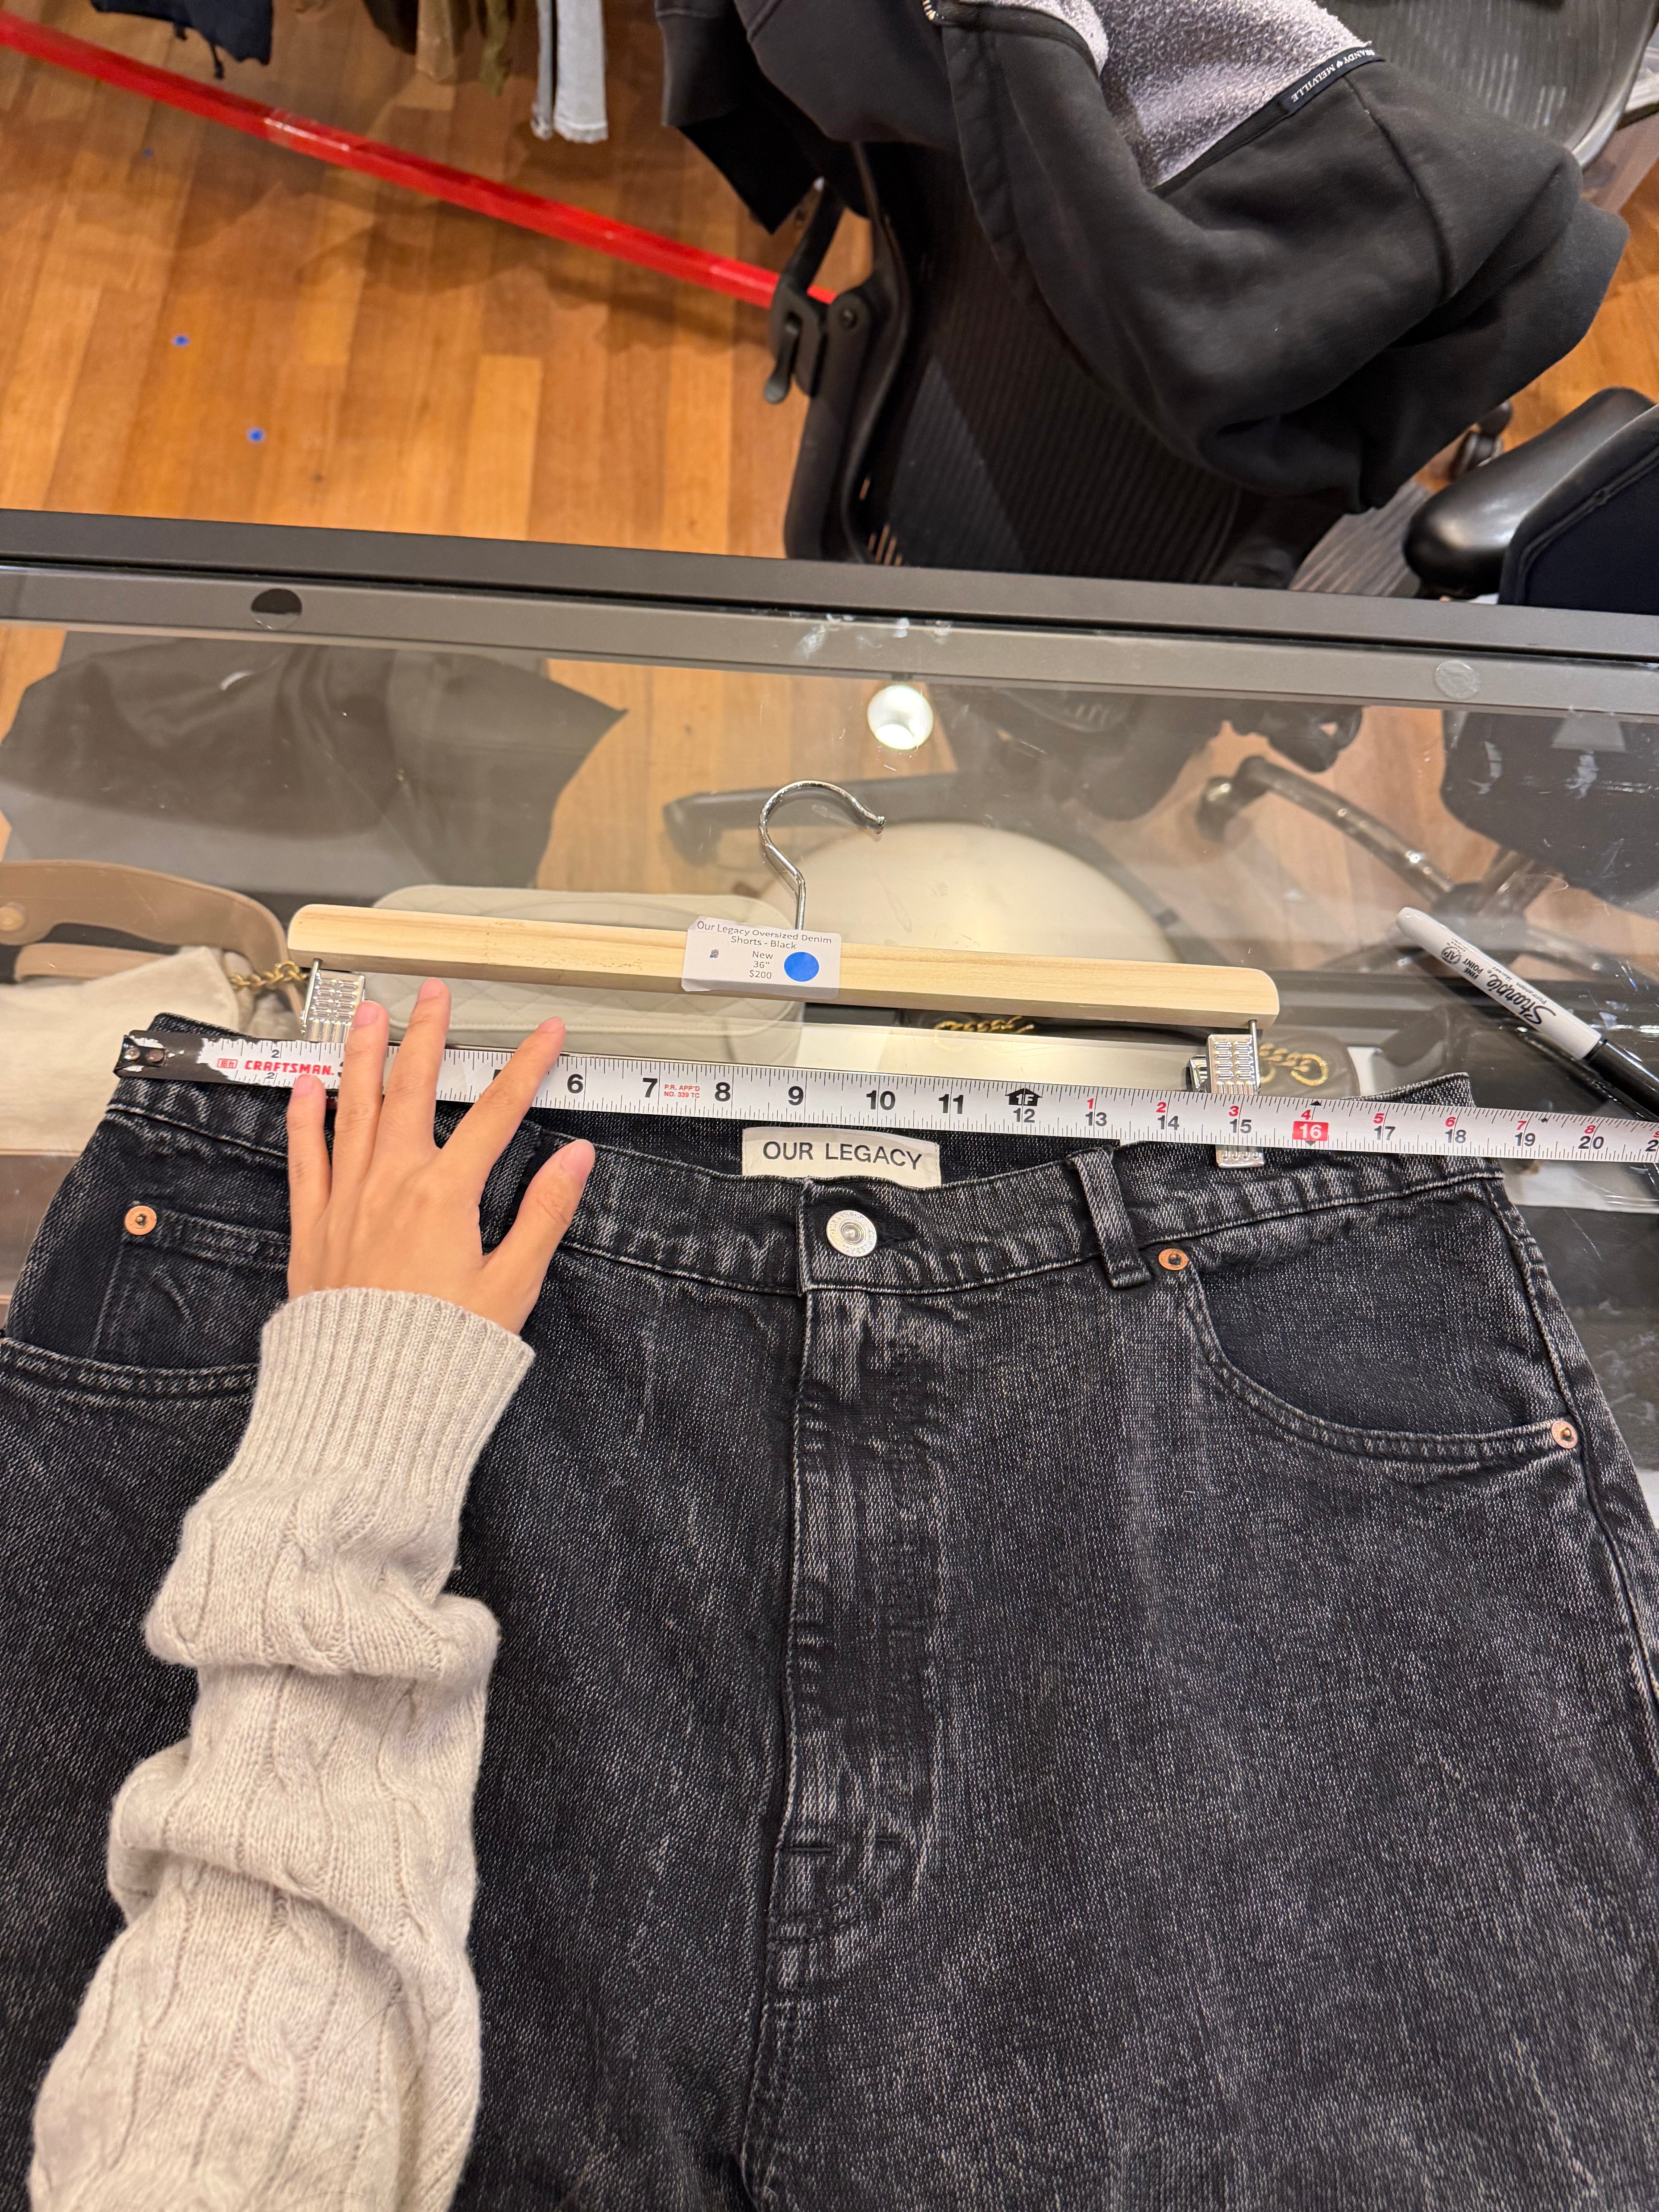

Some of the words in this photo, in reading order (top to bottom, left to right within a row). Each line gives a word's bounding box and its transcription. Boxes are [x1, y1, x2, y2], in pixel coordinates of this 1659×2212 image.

[1344, 49, 1375, 64] BRANDY
[1291, 64, 1335, 102] MELVILLE
[697, 921, 715, 931] Our
[717, 924, 750, 936] Legacy
[752, 929, 798, 941] Oversized
[801, 934, 832, 944] Denim
[731, 935, 762, 946] Shorts
[771, 940, 796, 950] Black
[753, 951, 773, 960] New
[753, 960, 769, 969] 36"
[1462, 958, 1483, 974] POINT
[749, 969, 772, 979] $200
[1464, 967, 1479, 979] FINE
[1487, 974, 1556, 1024] Sharpie
[271, 1050, 280, 1058] 2
[245, 1060, 332, 1075] CRAFTSMAN
[1016, 1093, 1034, 1105] 1F
[567, 1074, 584, 1093] 6
[642, 1077, 658, 1098] 7
[715, 1082, 731, 1102] 8
[788, 1086, 804, 1106] 9
[866, 1090, 896, 1111] 10
[938, 1094, 964, 1115] 11
[1014, 1108, 1036, 1123] 12
[1085, 1112, 1107, 1126] 13
[1157, 1115, 1179, 1131] 14
[1230, 1119, 1252, 1134] 15
[1299, 1124, 1322, 1139] 16
[1374, 1126, 1396, 1141] 17
[1445, 1129, 1466, 1144] 18
[1515, 1132, 1535, 1147] 19
[1578, 1136, 1604, 1150] 20
[1645, 1140, 1659, 1151] 2
[1087, 1098, 1094, 1109] 1
[1156, 1102, 1166, 1113] 2
[1229, 1106, 1239, 1116] 3
[1301, 1109, 1311, 1120] 4
[1373, 1113, 1385, 1124] 5
[1445, 1117, 1456, 1127] 6
[1516, 1120, 1527, 1131] 7
[1584, 1125, 1596, 1134] 8
[763, 1141, 814, 1160] OUR
[826, 1143, 922, 1170] LEGACY
